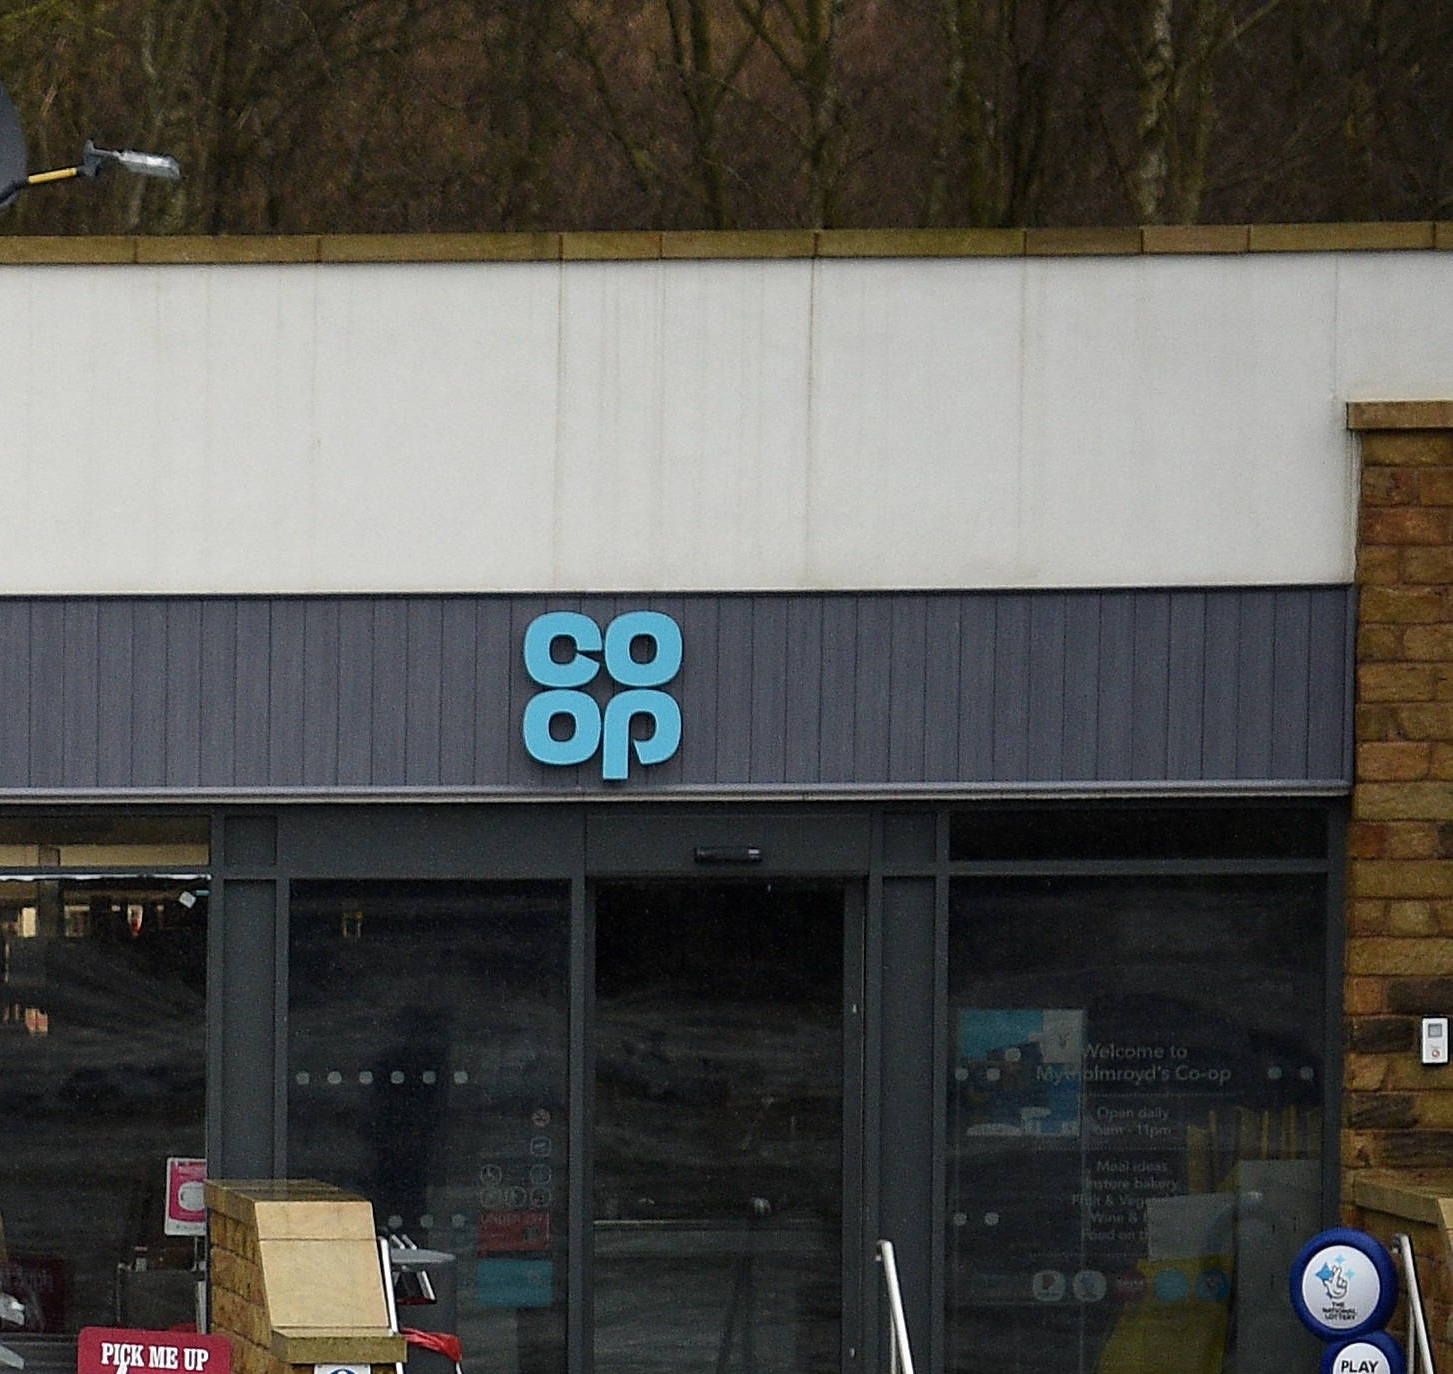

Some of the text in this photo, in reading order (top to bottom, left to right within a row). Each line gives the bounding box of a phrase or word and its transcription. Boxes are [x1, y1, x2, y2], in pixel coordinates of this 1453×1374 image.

[1082, 1043, 1188, 1060] Welcome to
[1036, 1064, 1231, 1086] Mytolmroyd's Co-op
[1096, 1105, 1170, 1123] Open daily
[101, 1342, 209, 1371] PICK ME UP
[1340, 1360, 1379, 1374] PLAY
